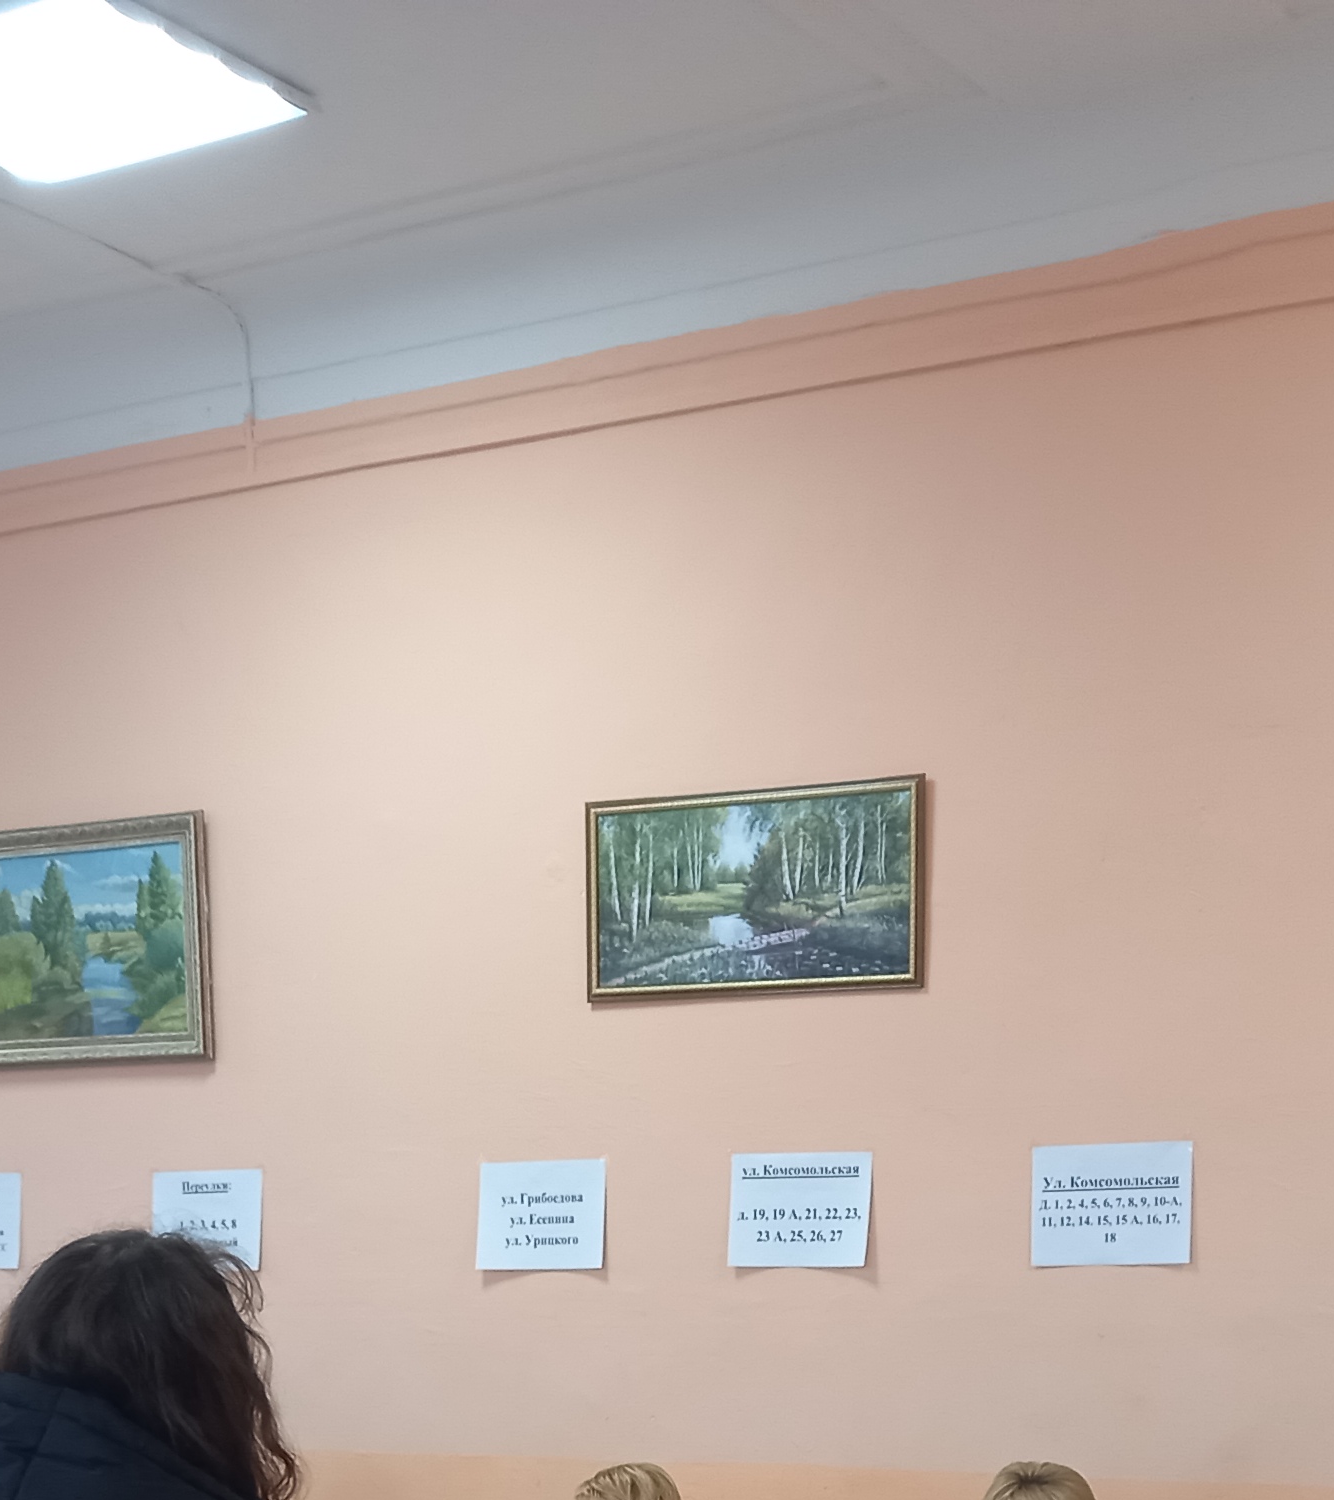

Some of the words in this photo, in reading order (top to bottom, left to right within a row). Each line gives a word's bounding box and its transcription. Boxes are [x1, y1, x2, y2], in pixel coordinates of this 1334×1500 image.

[741, 1166, 761, 1179] ул.
[763, 1164, 860, 1178] Комсомольская
[1043, 1176, 1067, 1190] Ул.
[1070, 1175, 1180, 1189] Комсомольская
[501, 1195, 518, 1208] ул.
[509, 1215, 527, 1229] ул.
[529, 1213, 576, 1226] Есенина
[752, 1208, 769, 1221] 19,
[772, 1208, 786, 1221] 19
[805, 1207, 823, 1221] 21,
[825, 1207, 843, 1221] 22,
[845, 1207, 862, 1221] 23,
[1115, 1214, 1128, 1226] 15
[505, 1236, 523, 1249] ул.
[525, 1234, 579, 1250] Урицкого
[756, 1230, 771, 1243] 23
[789, 1229, 807, 1243] 25,
[809, 1229, 827, 1243] 26,
[829, 1229, 844, 1242] 27
[1104, 1232, 1117, 1244] 18
